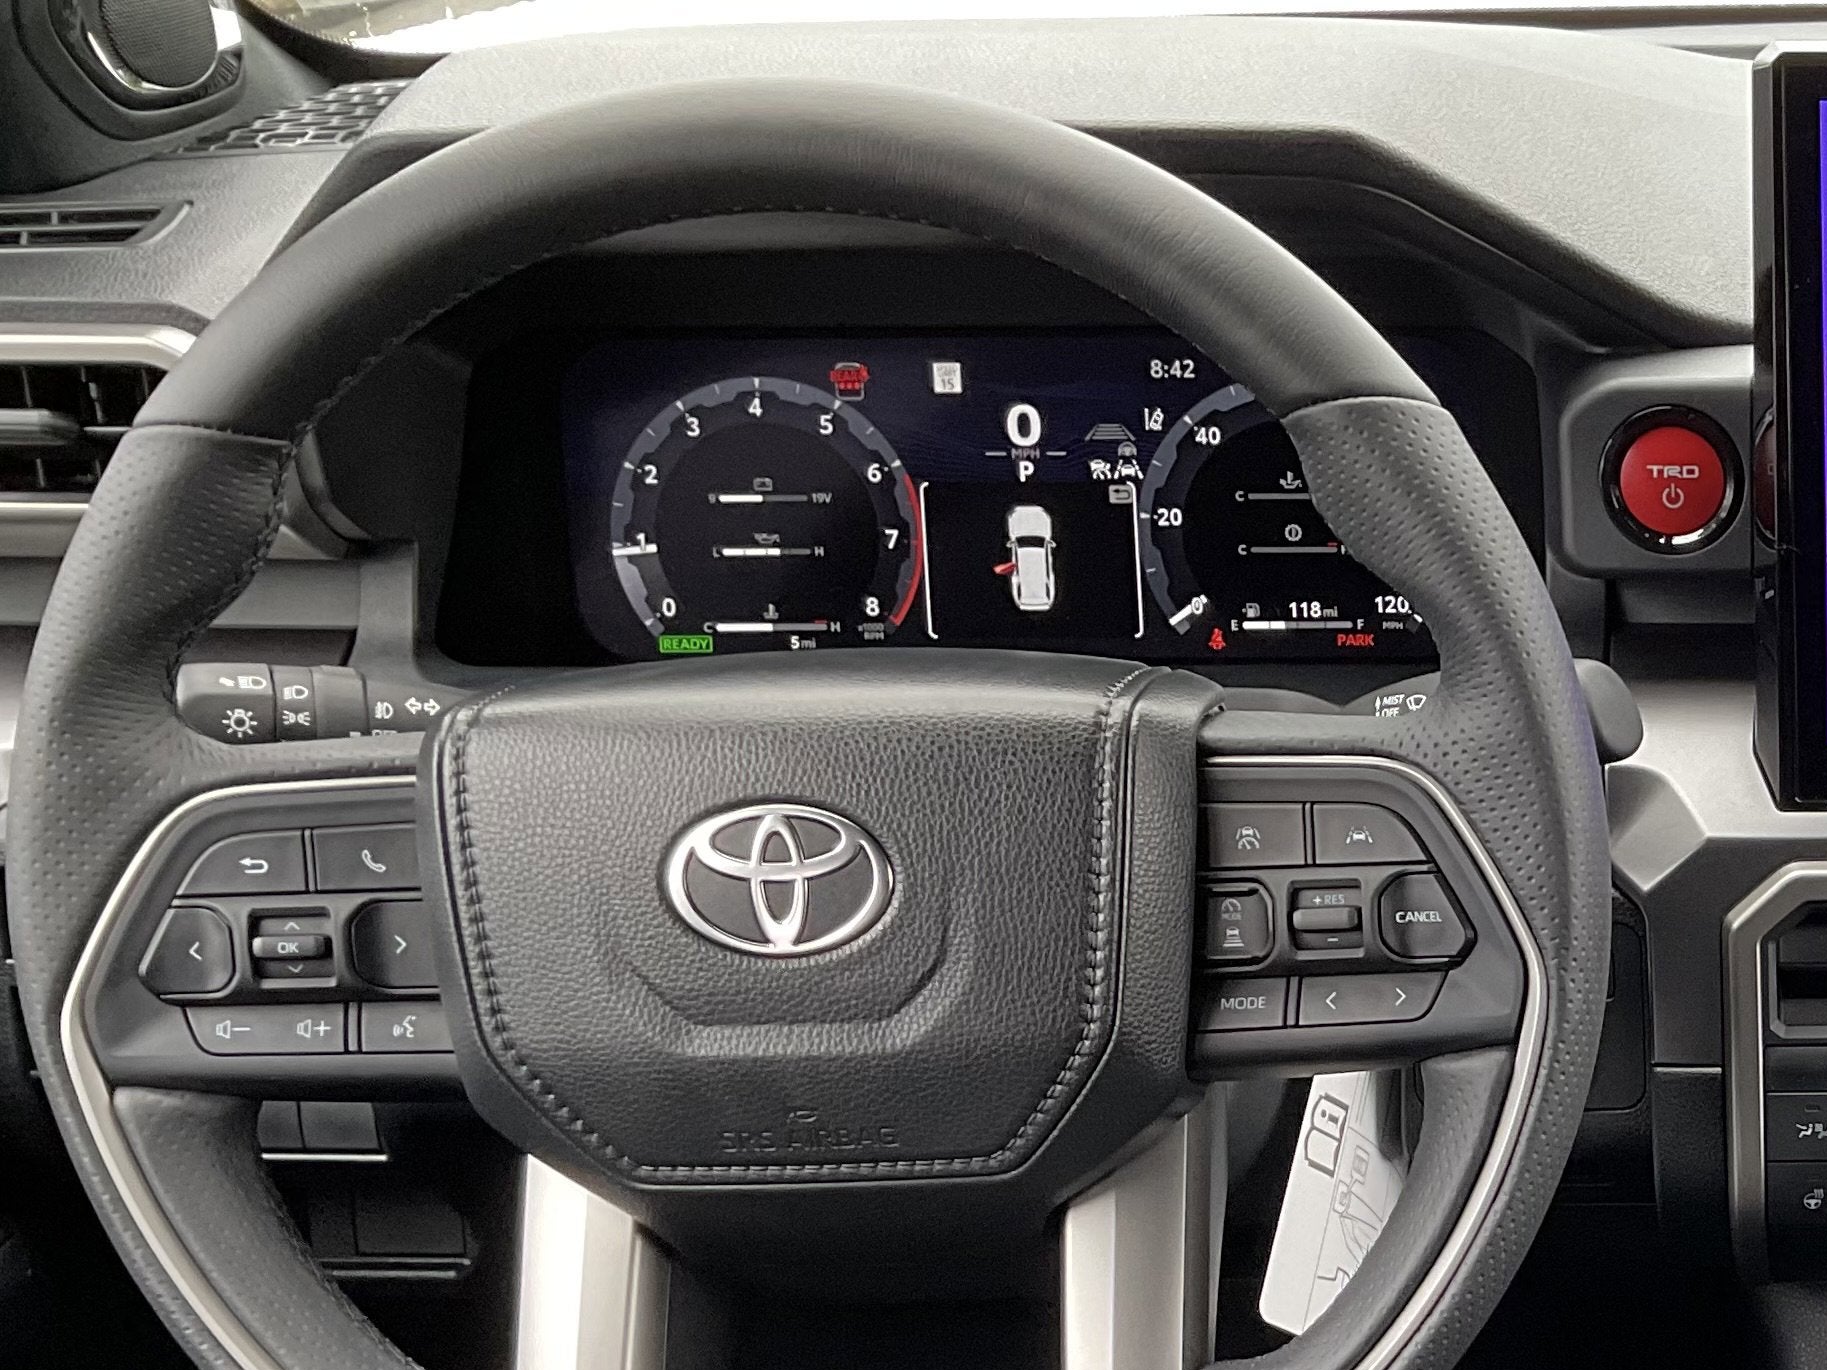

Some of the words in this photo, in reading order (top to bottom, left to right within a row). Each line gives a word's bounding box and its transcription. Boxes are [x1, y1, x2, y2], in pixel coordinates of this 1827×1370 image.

[1150, 360, 1196, 379] 8:42
[941, 377, 956, 391] 15
[748, 397, 763, 417] 4
[686, 417, 700, 437] 3
[818, 415, 834, 435] 5
[1006, 403, 1042, 447] 0
[1195, 426, 1221, 446] 40
[1011, 447, 1041, 460] MPH
[643, 465, 659, 484] 2
[867, 463, 882, 482] 6
[1019, 460, 1035, 482] P
[1646, 465, 1700, 479] TRD
[812, 493, 832, 503] 19V
[1157, 508, 1182, 526] 20
[637, 533, 647, 552] 1
[885, 530, 899, 549] 7
[814, 546, 824, 557] H
[661, 598, 676, 617] 0
[865, 598, 880, 617] 8
[1288, 602, 1322, 618] 118
[1323, 604, 1339, 618] mi
[1375, 595, 1409, 614] 120
[703, 621, 713, 633] C
[830, 621, 841, 632] H
[1231, 620, 1239, 632] E
[1357, 619, 1365, 630] F
[663, 638, 709, 650] READY
[790, 635, 800, 649] 5
[1337, 633, 1375, 646] PARK
[1381, 707, 1400, 717] OFF
[1395, 911, 1442, 924] CANCEL
[277, 942, 299, 954] OK
[1220, 996, 1266, 1010] MODE
